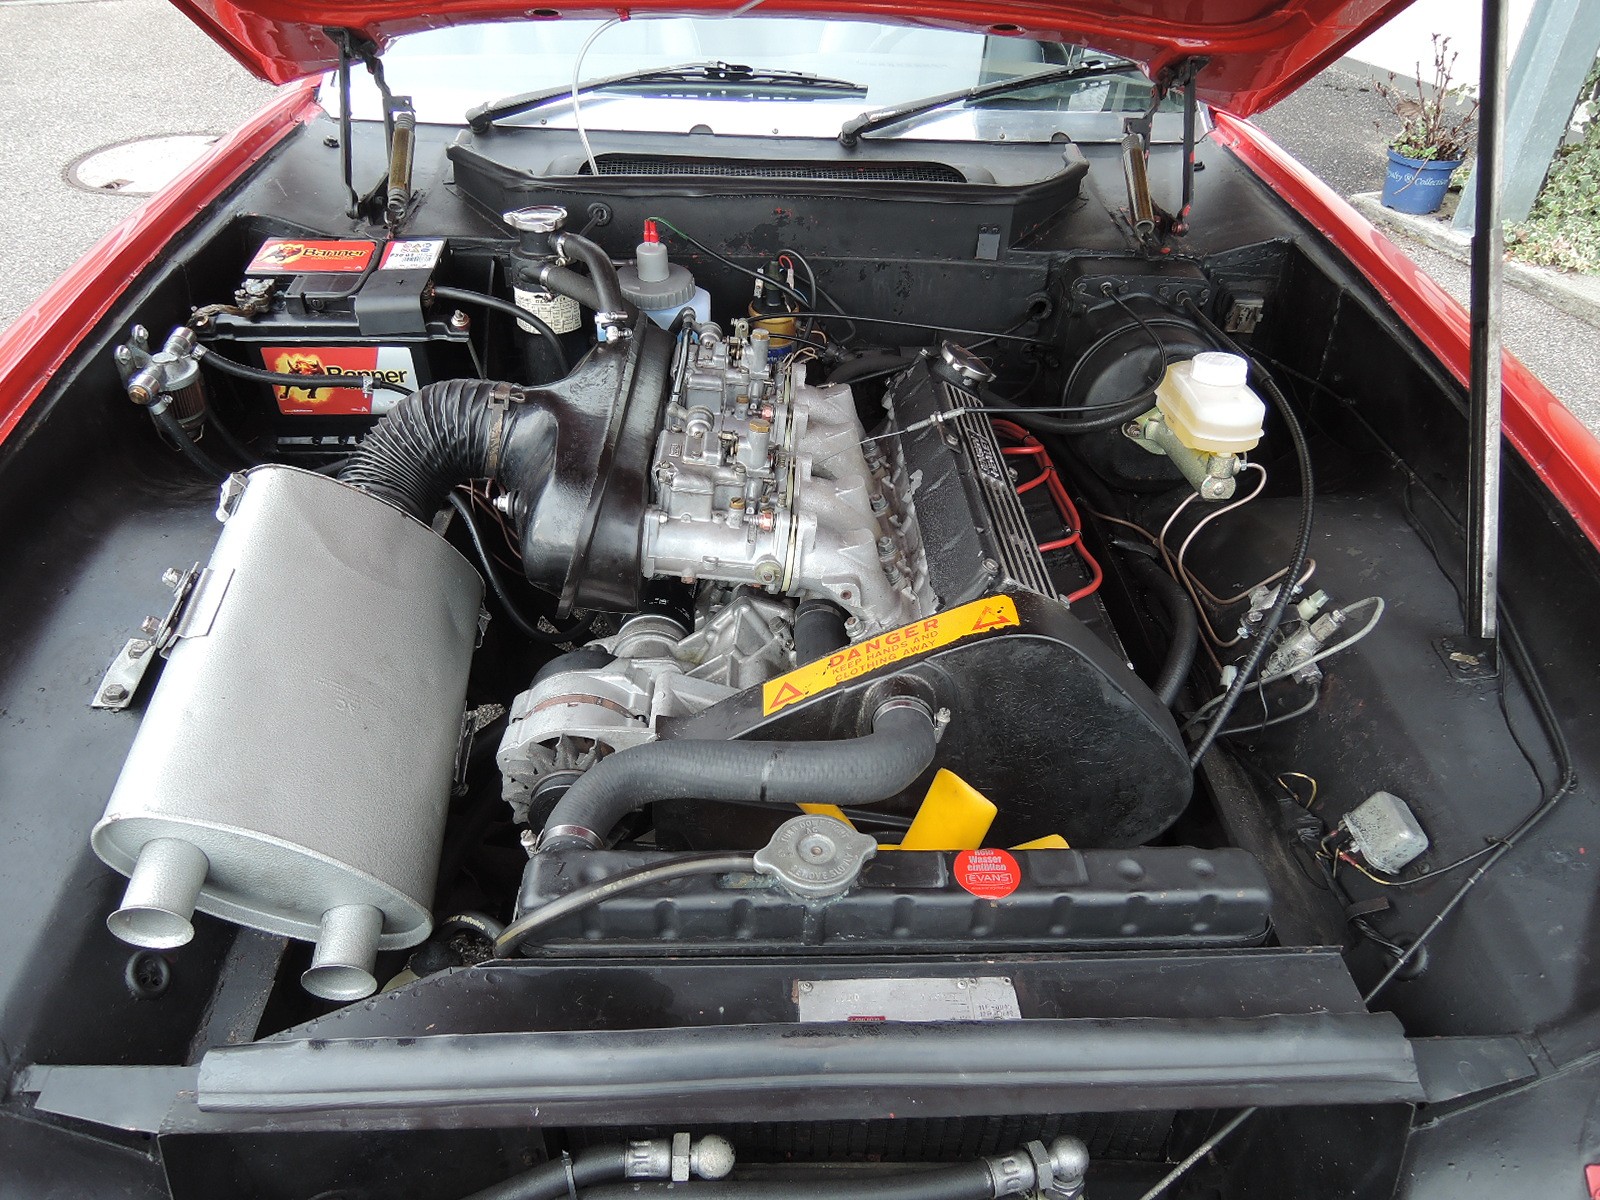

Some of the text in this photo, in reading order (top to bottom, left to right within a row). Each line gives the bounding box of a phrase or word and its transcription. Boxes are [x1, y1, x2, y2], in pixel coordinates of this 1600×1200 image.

[302, 248, 369, 257] Banner
[829, 618, 939, 668] DANGER
[832, 630, 939, 675] KEEP HANDS AND
[835, 639, 936, 682] CLOTHING AWAY
[969, 874, 1009, 882] EVANS
